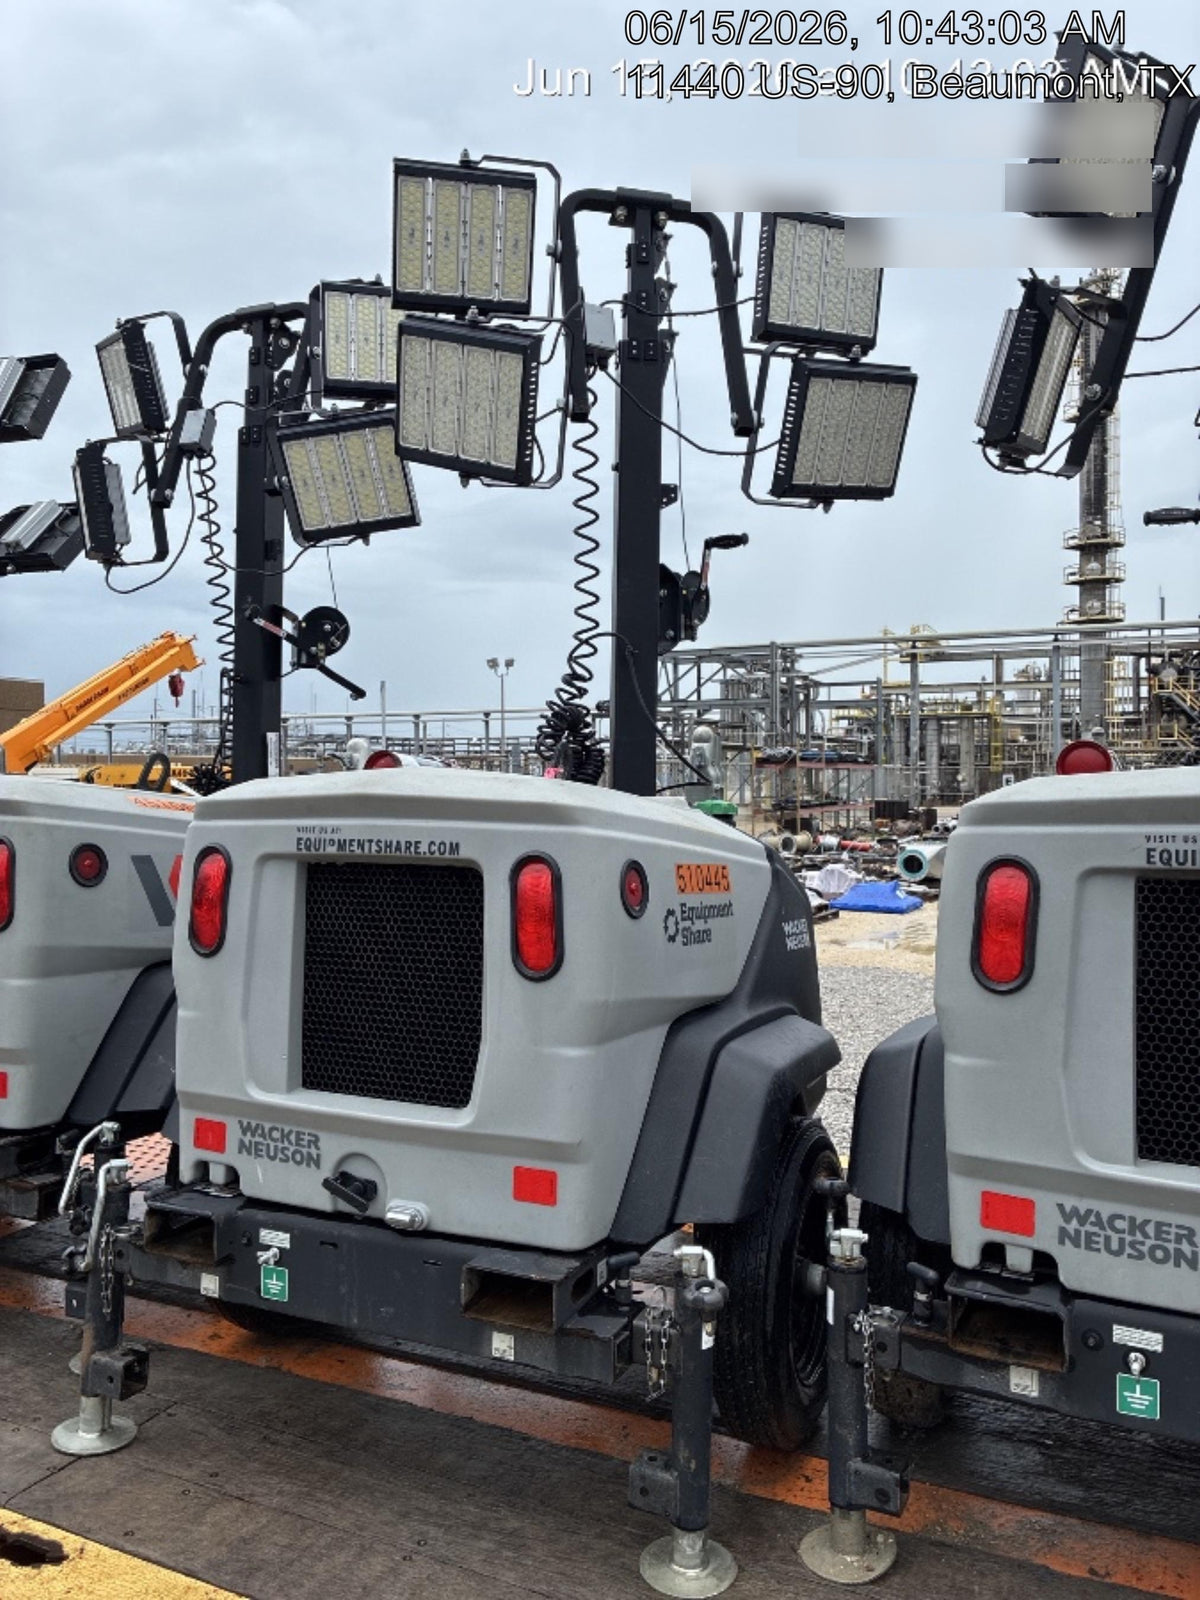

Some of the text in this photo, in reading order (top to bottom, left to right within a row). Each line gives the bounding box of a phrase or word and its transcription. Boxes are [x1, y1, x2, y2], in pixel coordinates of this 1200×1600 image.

[296, 836, 460, 856] EQUIPMENTSHARE.COM
[1145, 834, 1176, 844] VISIT
[677, 865, 730, 893] 510445
[680, 900, 733, 925] Equipment
[681, 926, 712, 946] Share
[237, 1119, 321, 1151] WACKER
[237, 1137, 321, 1170] NEUSON
[1056, 1202, 1199, 1249] WACKER
[1057, 1225, 1199, 1272] NEUSON
